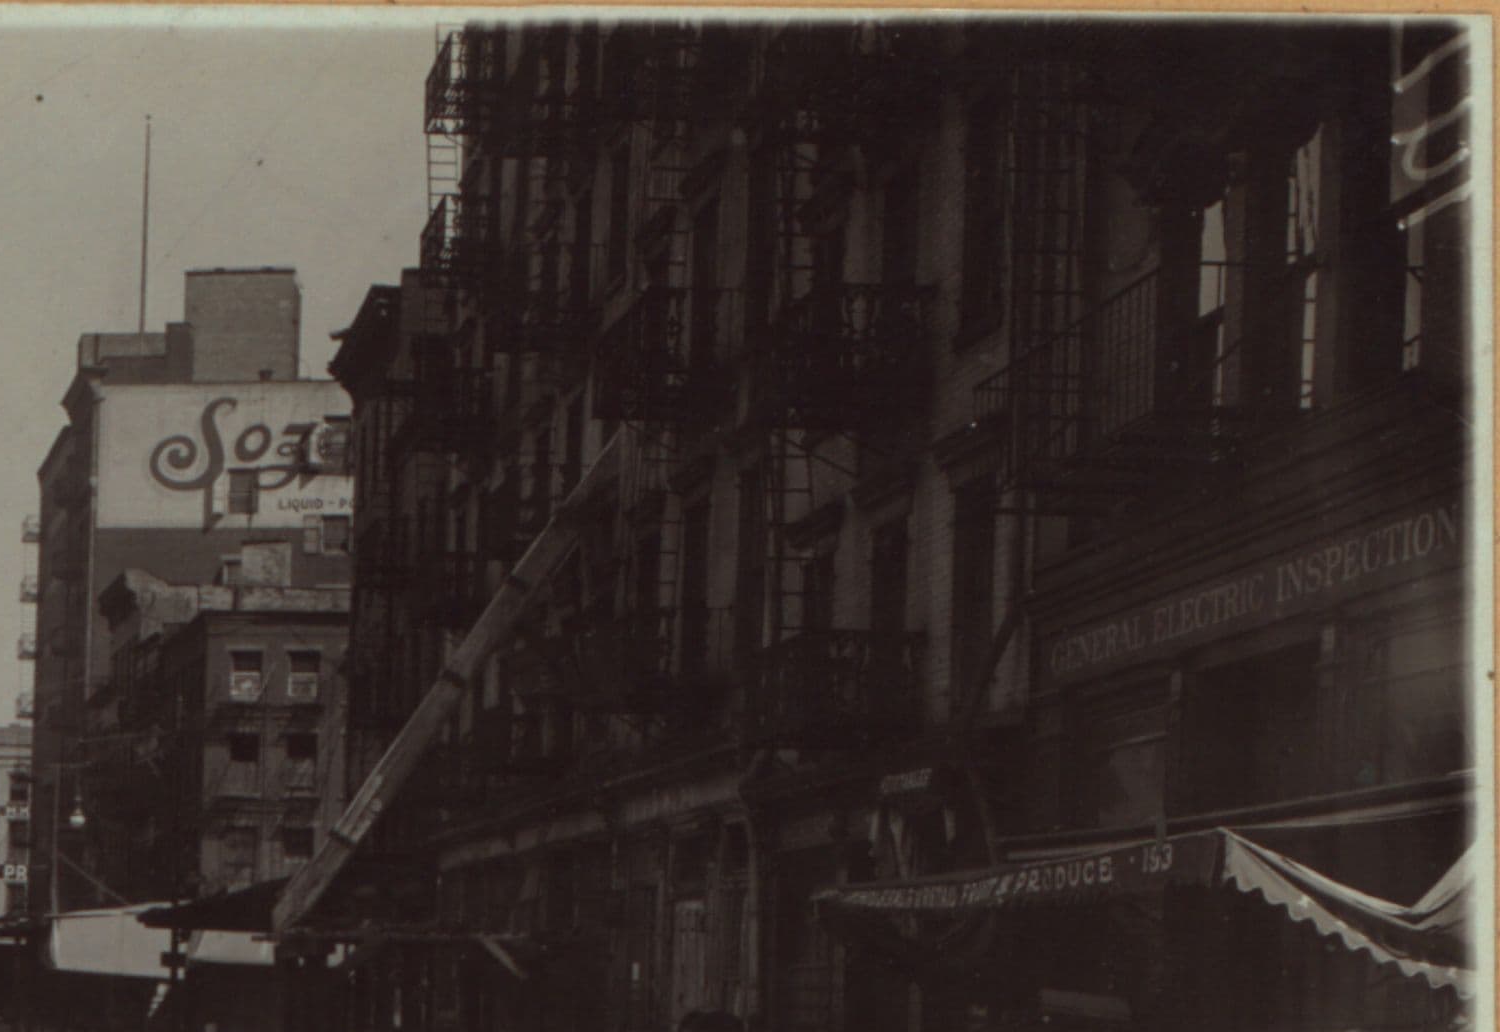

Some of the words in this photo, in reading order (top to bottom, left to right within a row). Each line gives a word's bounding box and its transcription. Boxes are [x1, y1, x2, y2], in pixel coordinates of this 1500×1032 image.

[278, 498, 324, 512] LIQUID
[1051, 614, 1146, 675] GENERAL
[1152, 574, 1268, 645] ELECTRIC
[1276, 507, 1460, 604] INSPECTION
[1013, 856, 1113, 894] PRODUCE
